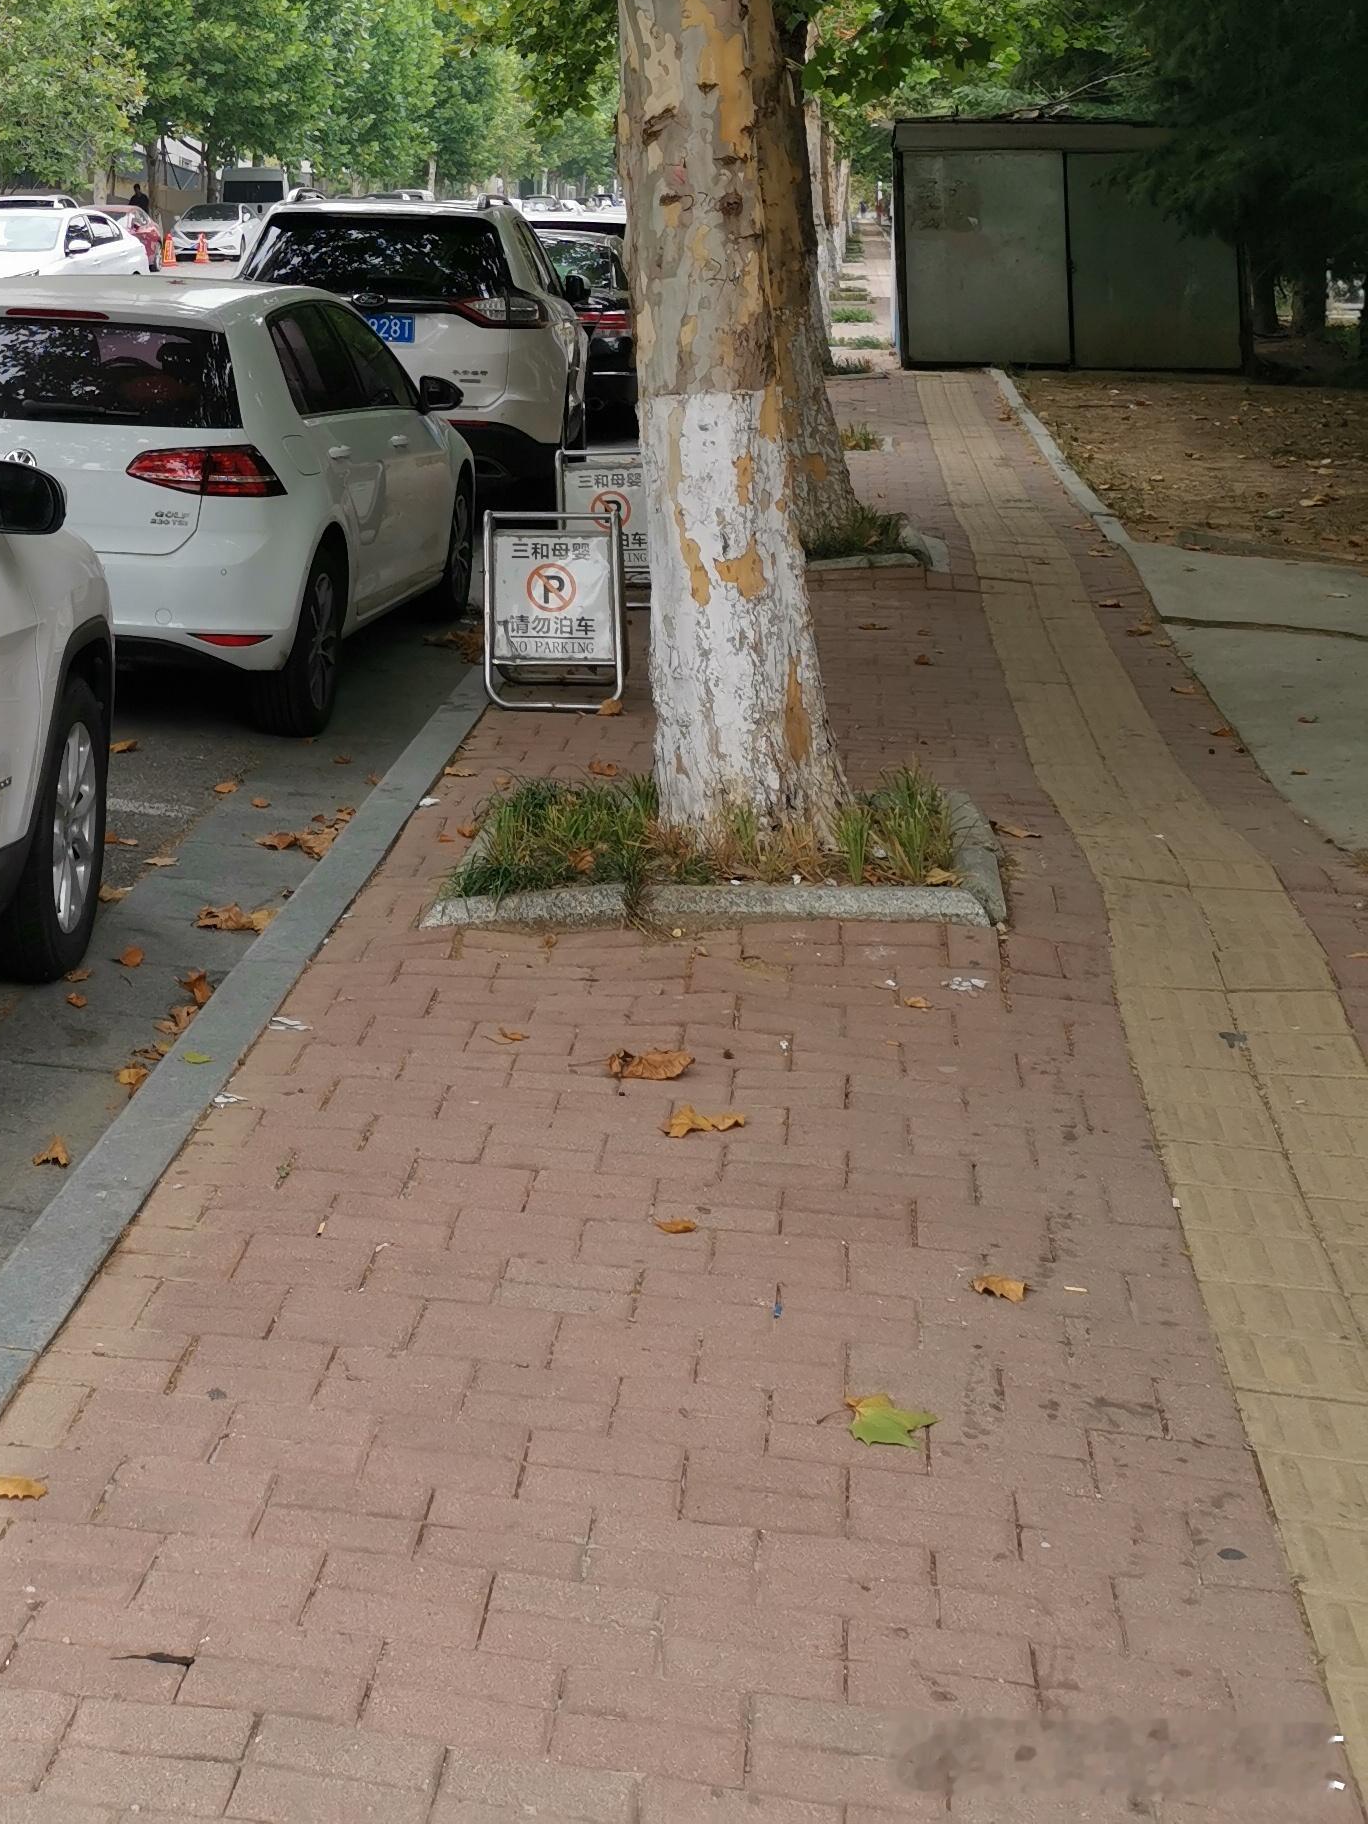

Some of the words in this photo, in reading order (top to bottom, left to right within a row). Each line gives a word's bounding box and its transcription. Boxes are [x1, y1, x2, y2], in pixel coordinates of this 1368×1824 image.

[578, 473, 642, 488] 三和母婴
[512, 542, 592, 560] 三和母婴
[625, 552, 647, 563] ING
[511, 615, 595, 635] 请勿泊车
[512, 640, 528, 653] NO
[535, 641, 595, 654] PARKING
